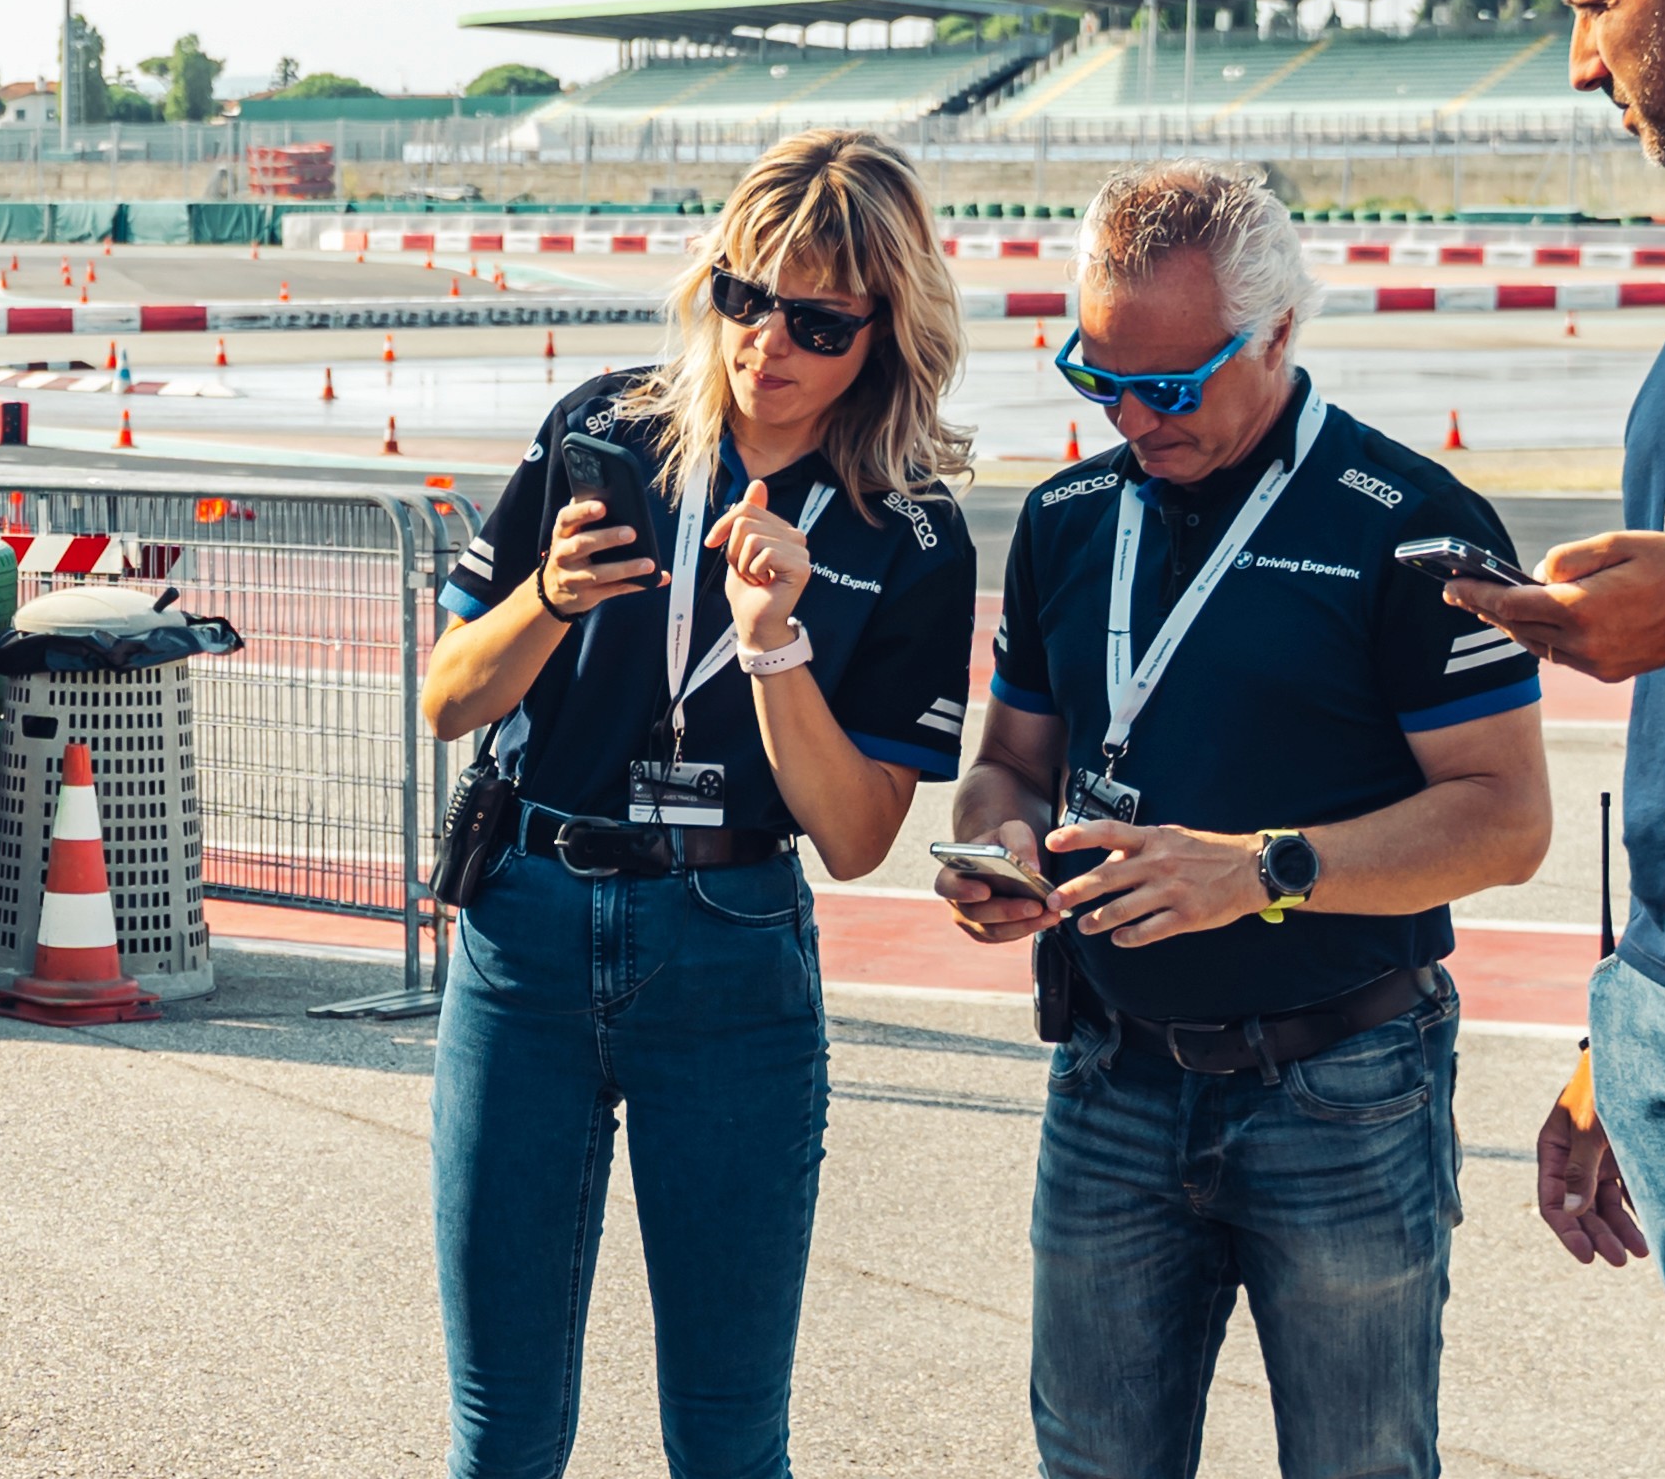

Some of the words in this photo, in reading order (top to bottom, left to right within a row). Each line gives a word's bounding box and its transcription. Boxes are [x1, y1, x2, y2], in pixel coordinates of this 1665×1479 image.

[1041, 473, 1119, 505] sparco
[1341, 469, 1403, 506] sparco
[885, 491, 937, 549] sparco
[810, 562, 839, 583] riving
[1256, 556, 1300, 572] Driving
[1301, 560, 1360, 579] Experienc
